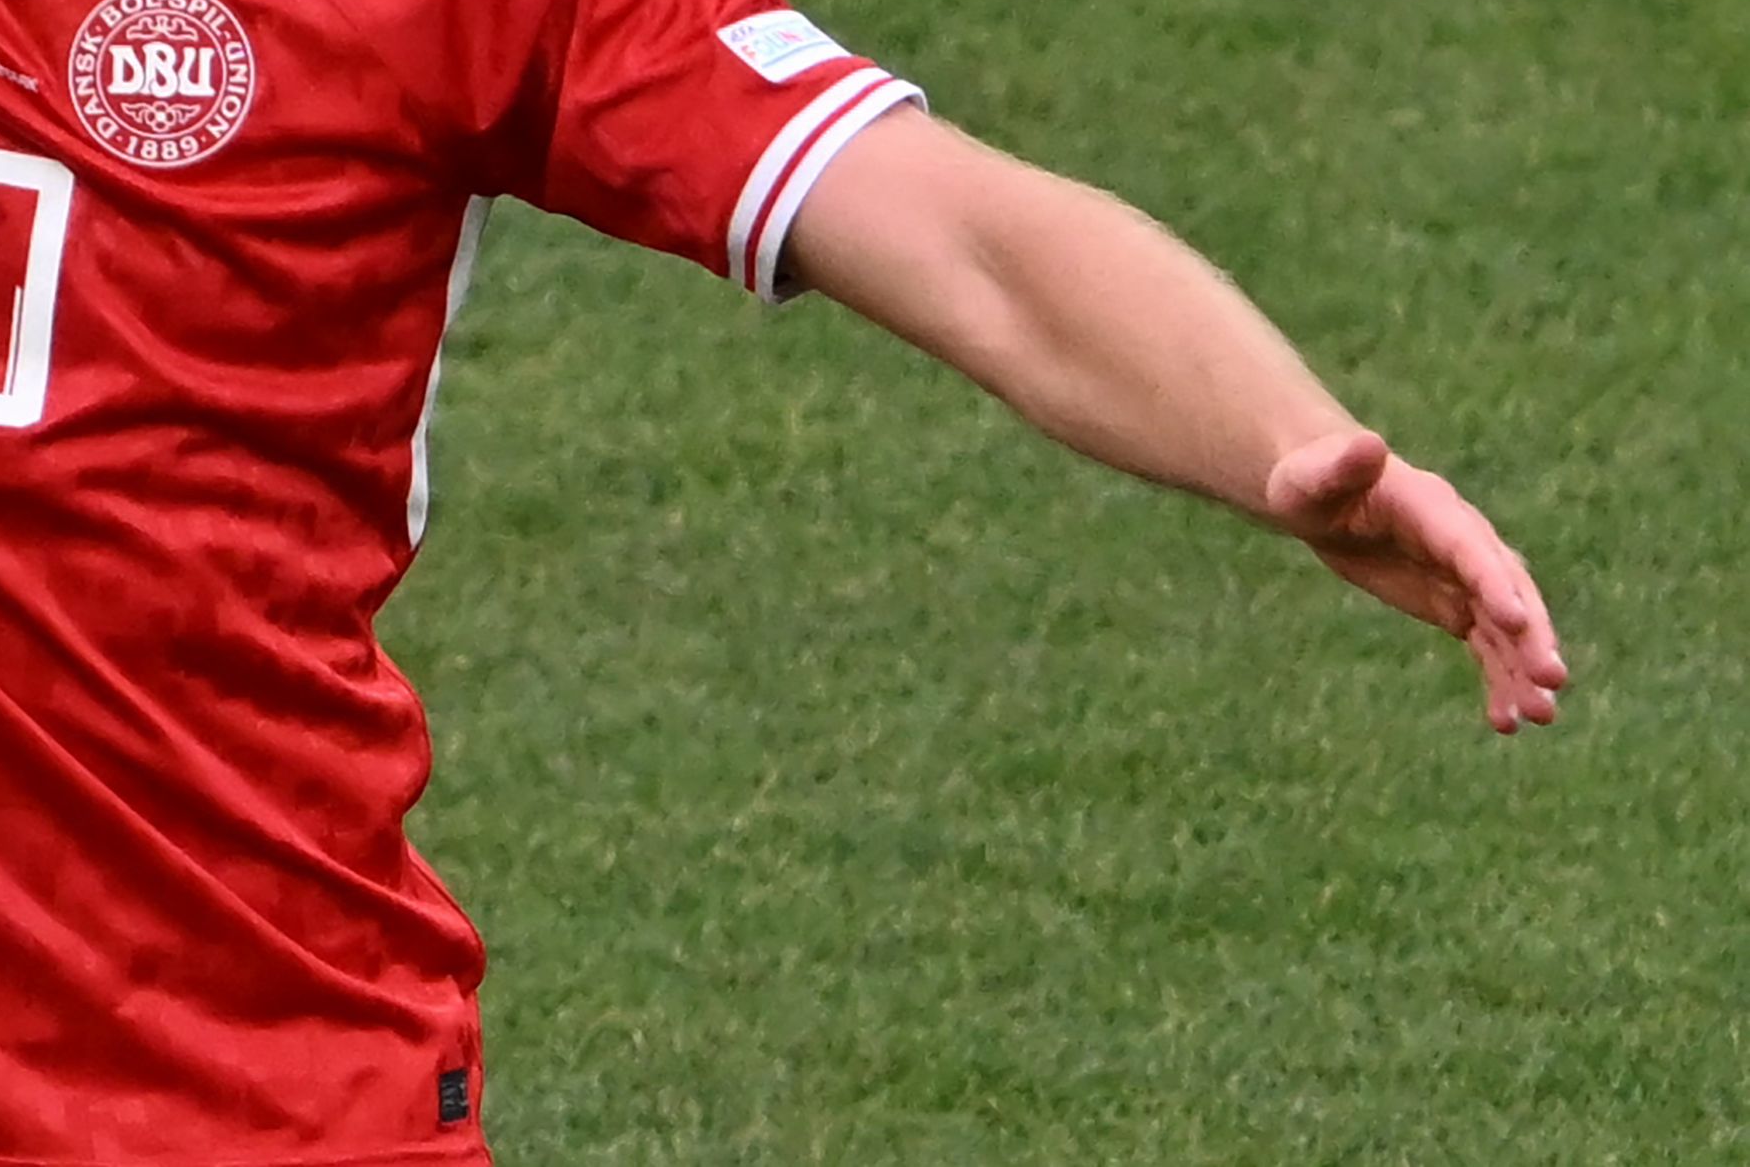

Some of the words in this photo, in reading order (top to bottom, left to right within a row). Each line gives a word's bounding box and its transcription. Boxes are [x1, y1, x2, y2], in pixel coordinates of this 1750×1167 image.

[75, 26, 119, 140] DANSK
[124, 135, 201, 161] 1889
[107, 41, 216, 99] DBU
